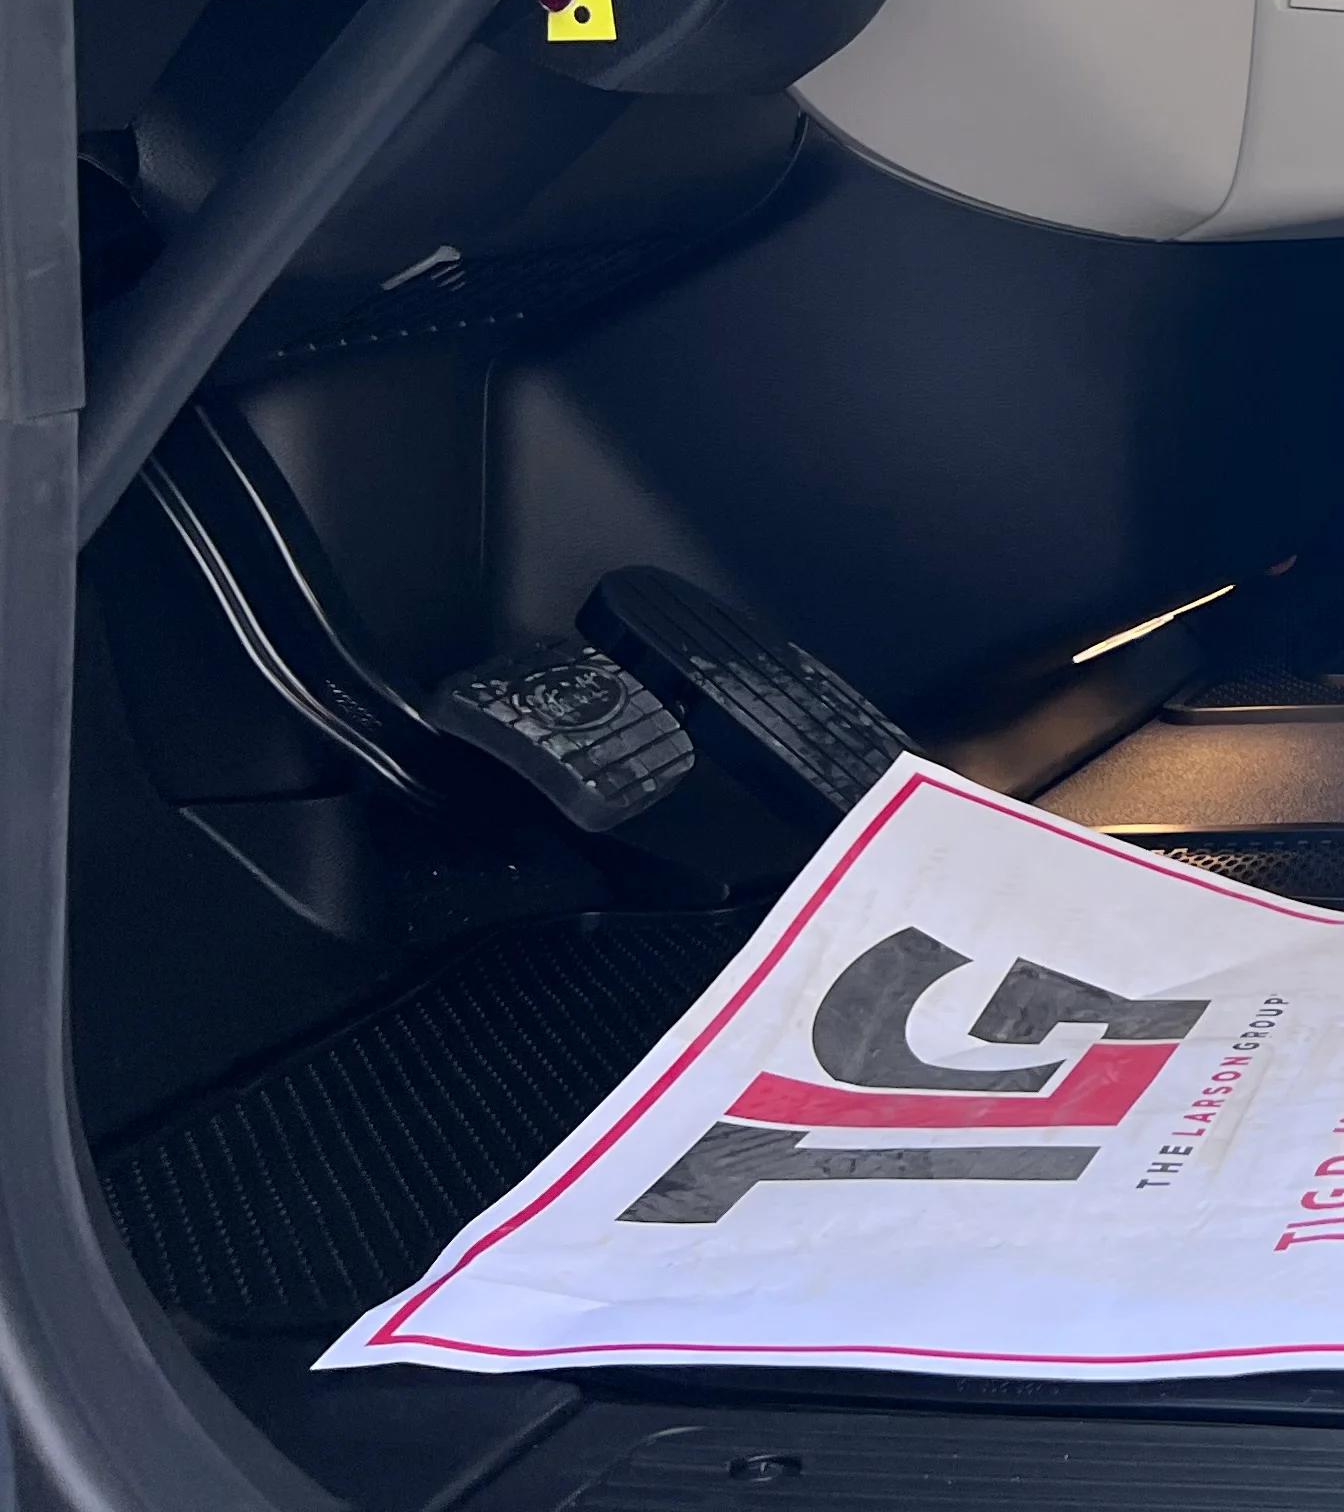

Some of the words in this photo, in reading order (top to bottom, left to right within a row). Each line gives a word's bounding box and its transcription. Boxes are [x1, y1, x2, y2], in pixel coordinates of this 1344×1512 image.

[615, 926, 1211, 1223] TLG
[1136, 1144, 1194, 1189] THE
[1171, 1056, 1251, 1137] LARSON
[1232, 996, 1289, 1051] GROUP
